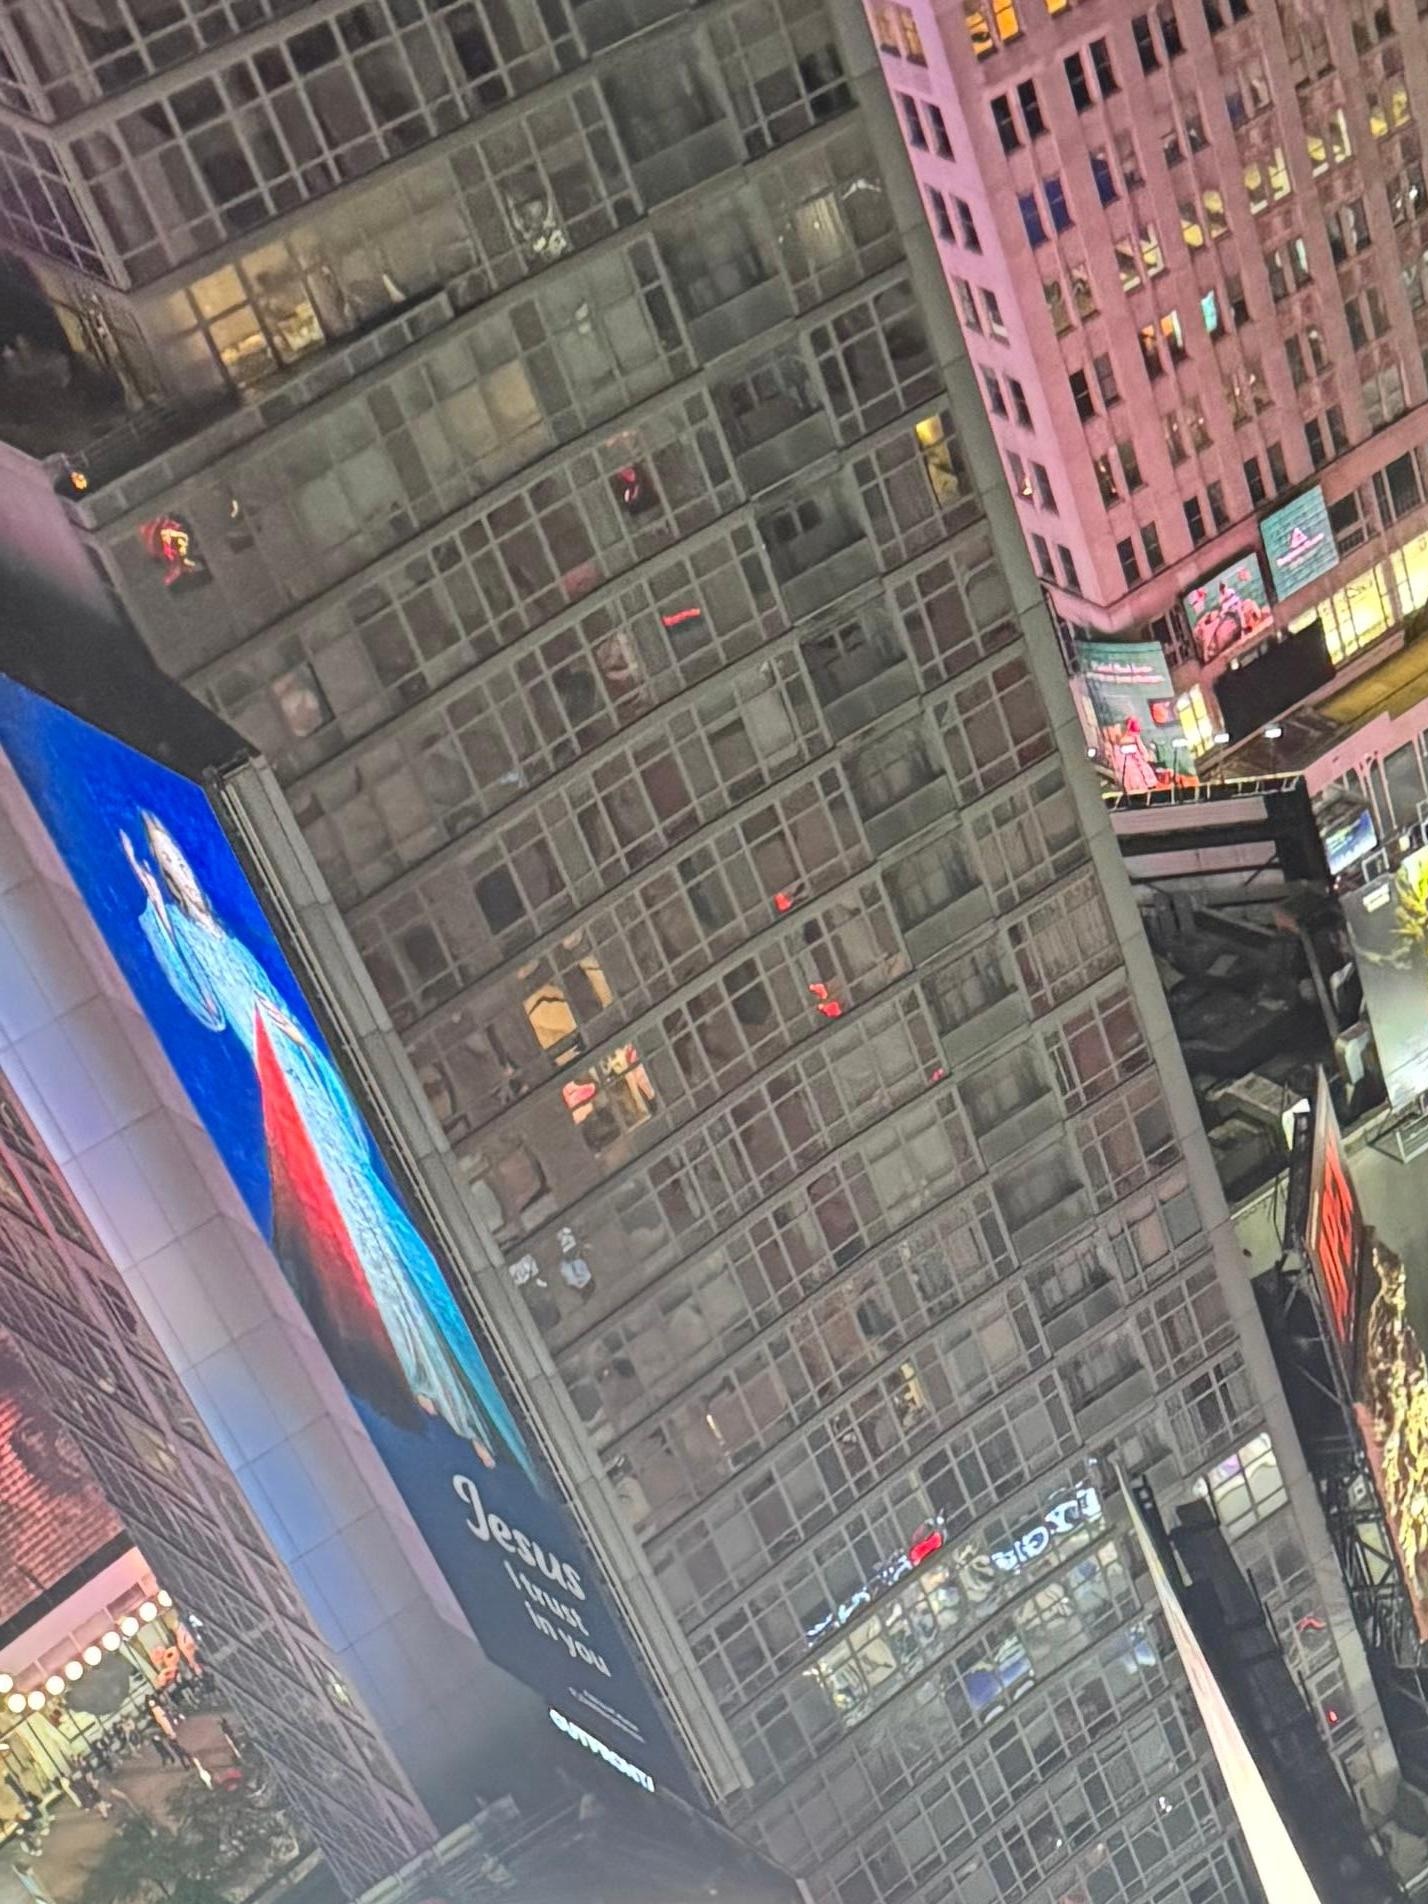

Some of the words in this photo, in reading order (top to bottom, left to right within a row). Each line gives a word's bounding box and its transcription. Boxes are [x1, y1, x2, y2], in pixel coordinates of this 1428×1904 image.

[452, 1474, 587, 1601] Jesus
[518, 1572, 590, 1637] trust
[524, 1600, 559, 1641] in
[556, 1628, 612, 1678] you
